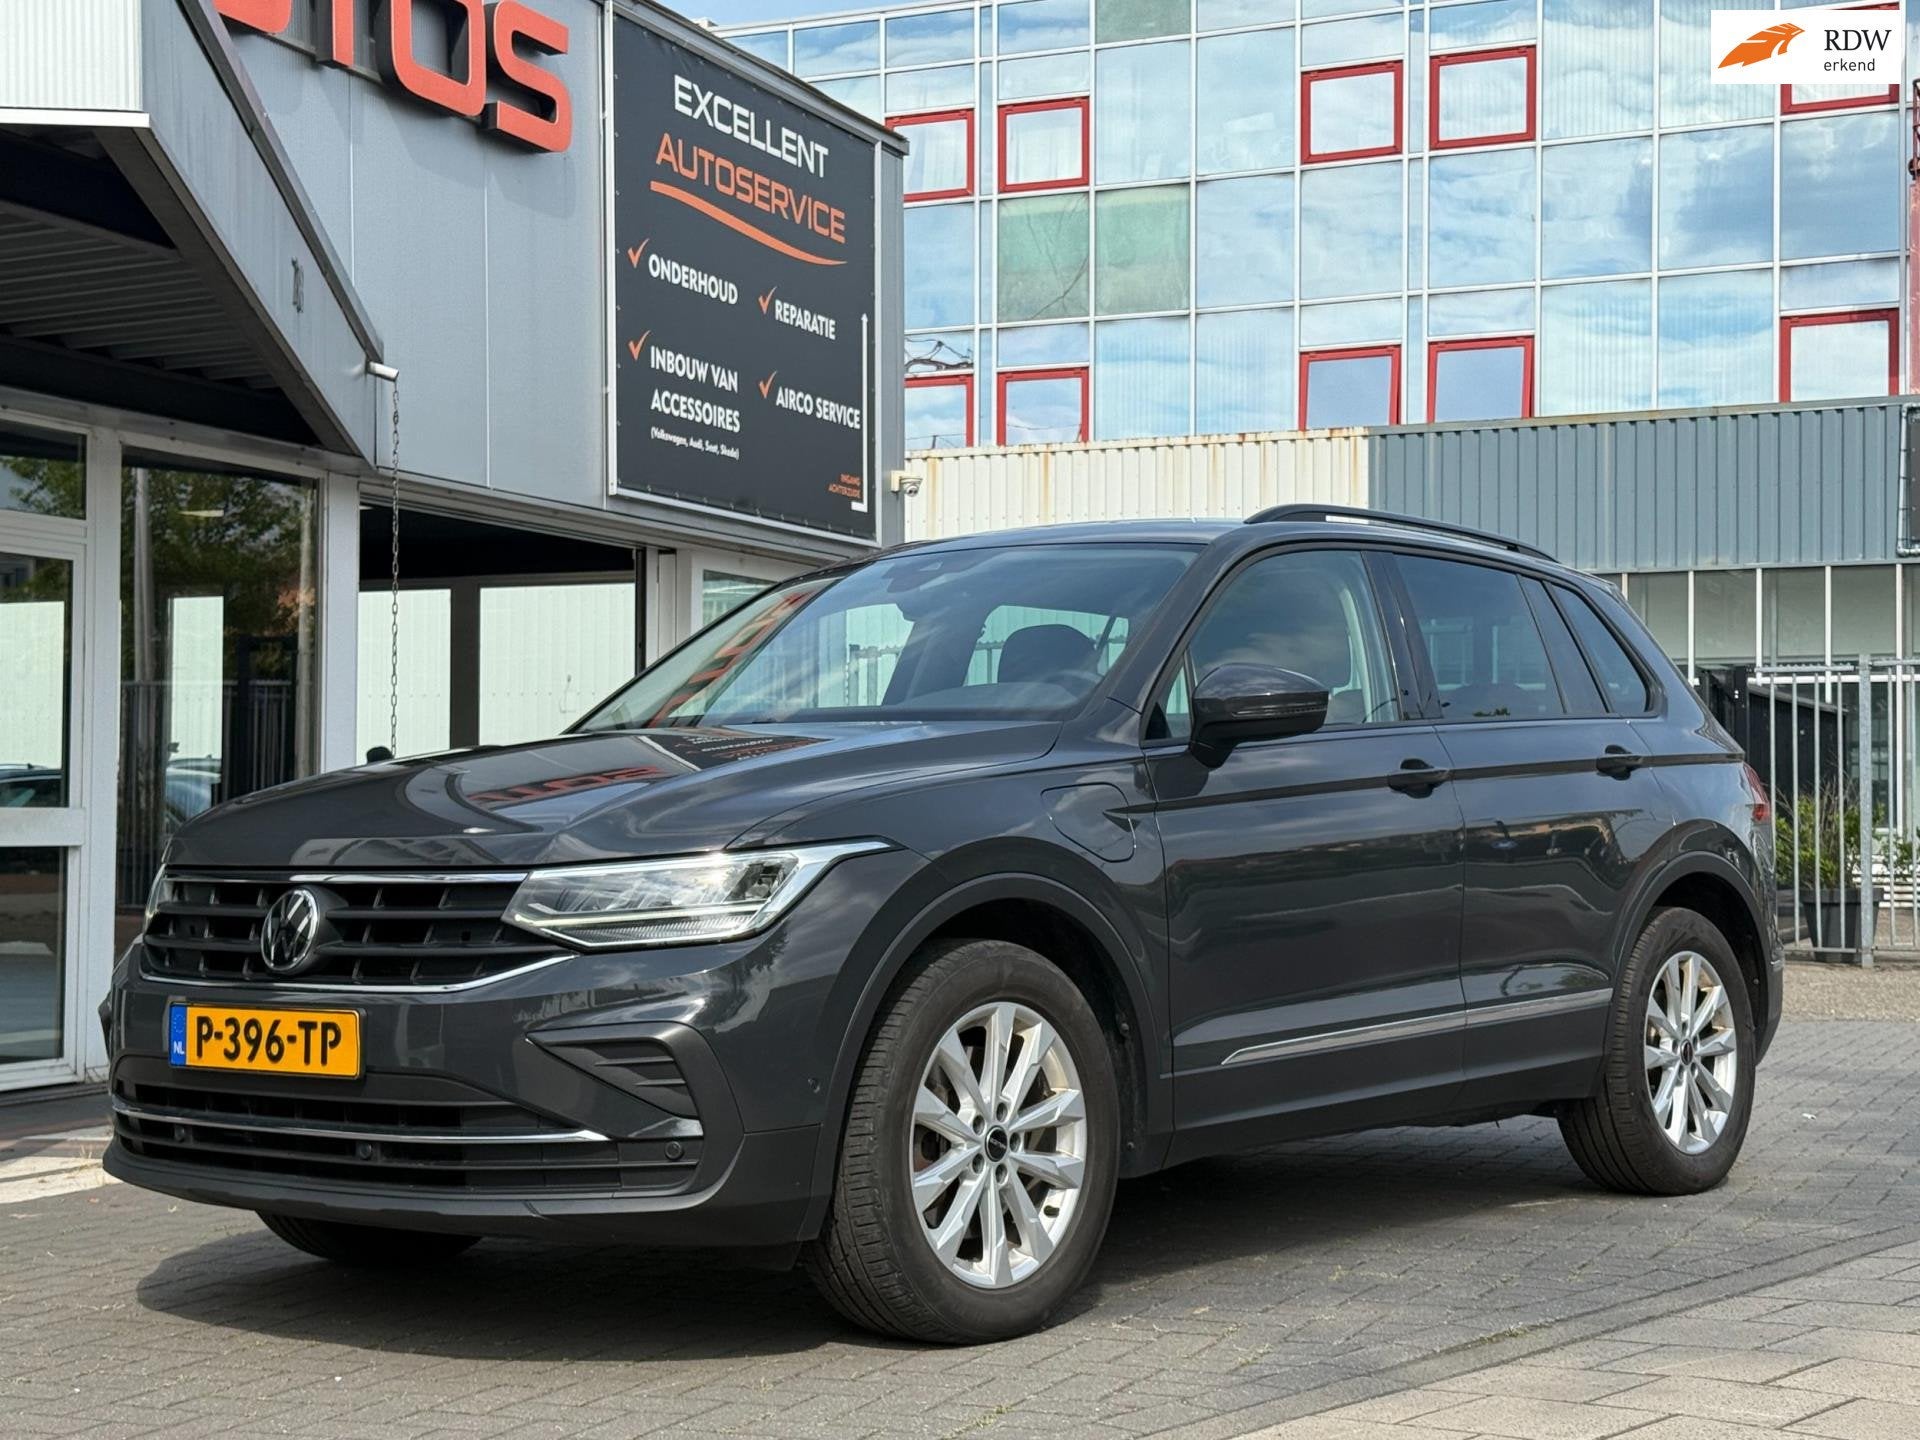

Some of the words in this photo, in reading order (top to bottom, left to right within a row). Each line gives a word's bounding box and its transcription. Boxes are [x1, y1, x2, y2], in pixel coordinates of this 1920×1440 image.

[673, 74, 829, 178] EXCELLENT
[655, 132, 846, 244] AUTOSERVICE
[648, 253, 739, 305] ONDERHOUD
[774, 299, 837, 340] REPARATIE
[650, 345, 710, 384] INBOUW
[710, 363, 739, 394] VAN
[650, 388, 741, 433] ACCESSOIRES
[775, 386, 814, 416] AIRCO
[815, 397, 861, 430] SERVICE
[173, 1042, 185, 1055] NL
[196, 1015, 342, 1067] P-396-TP
